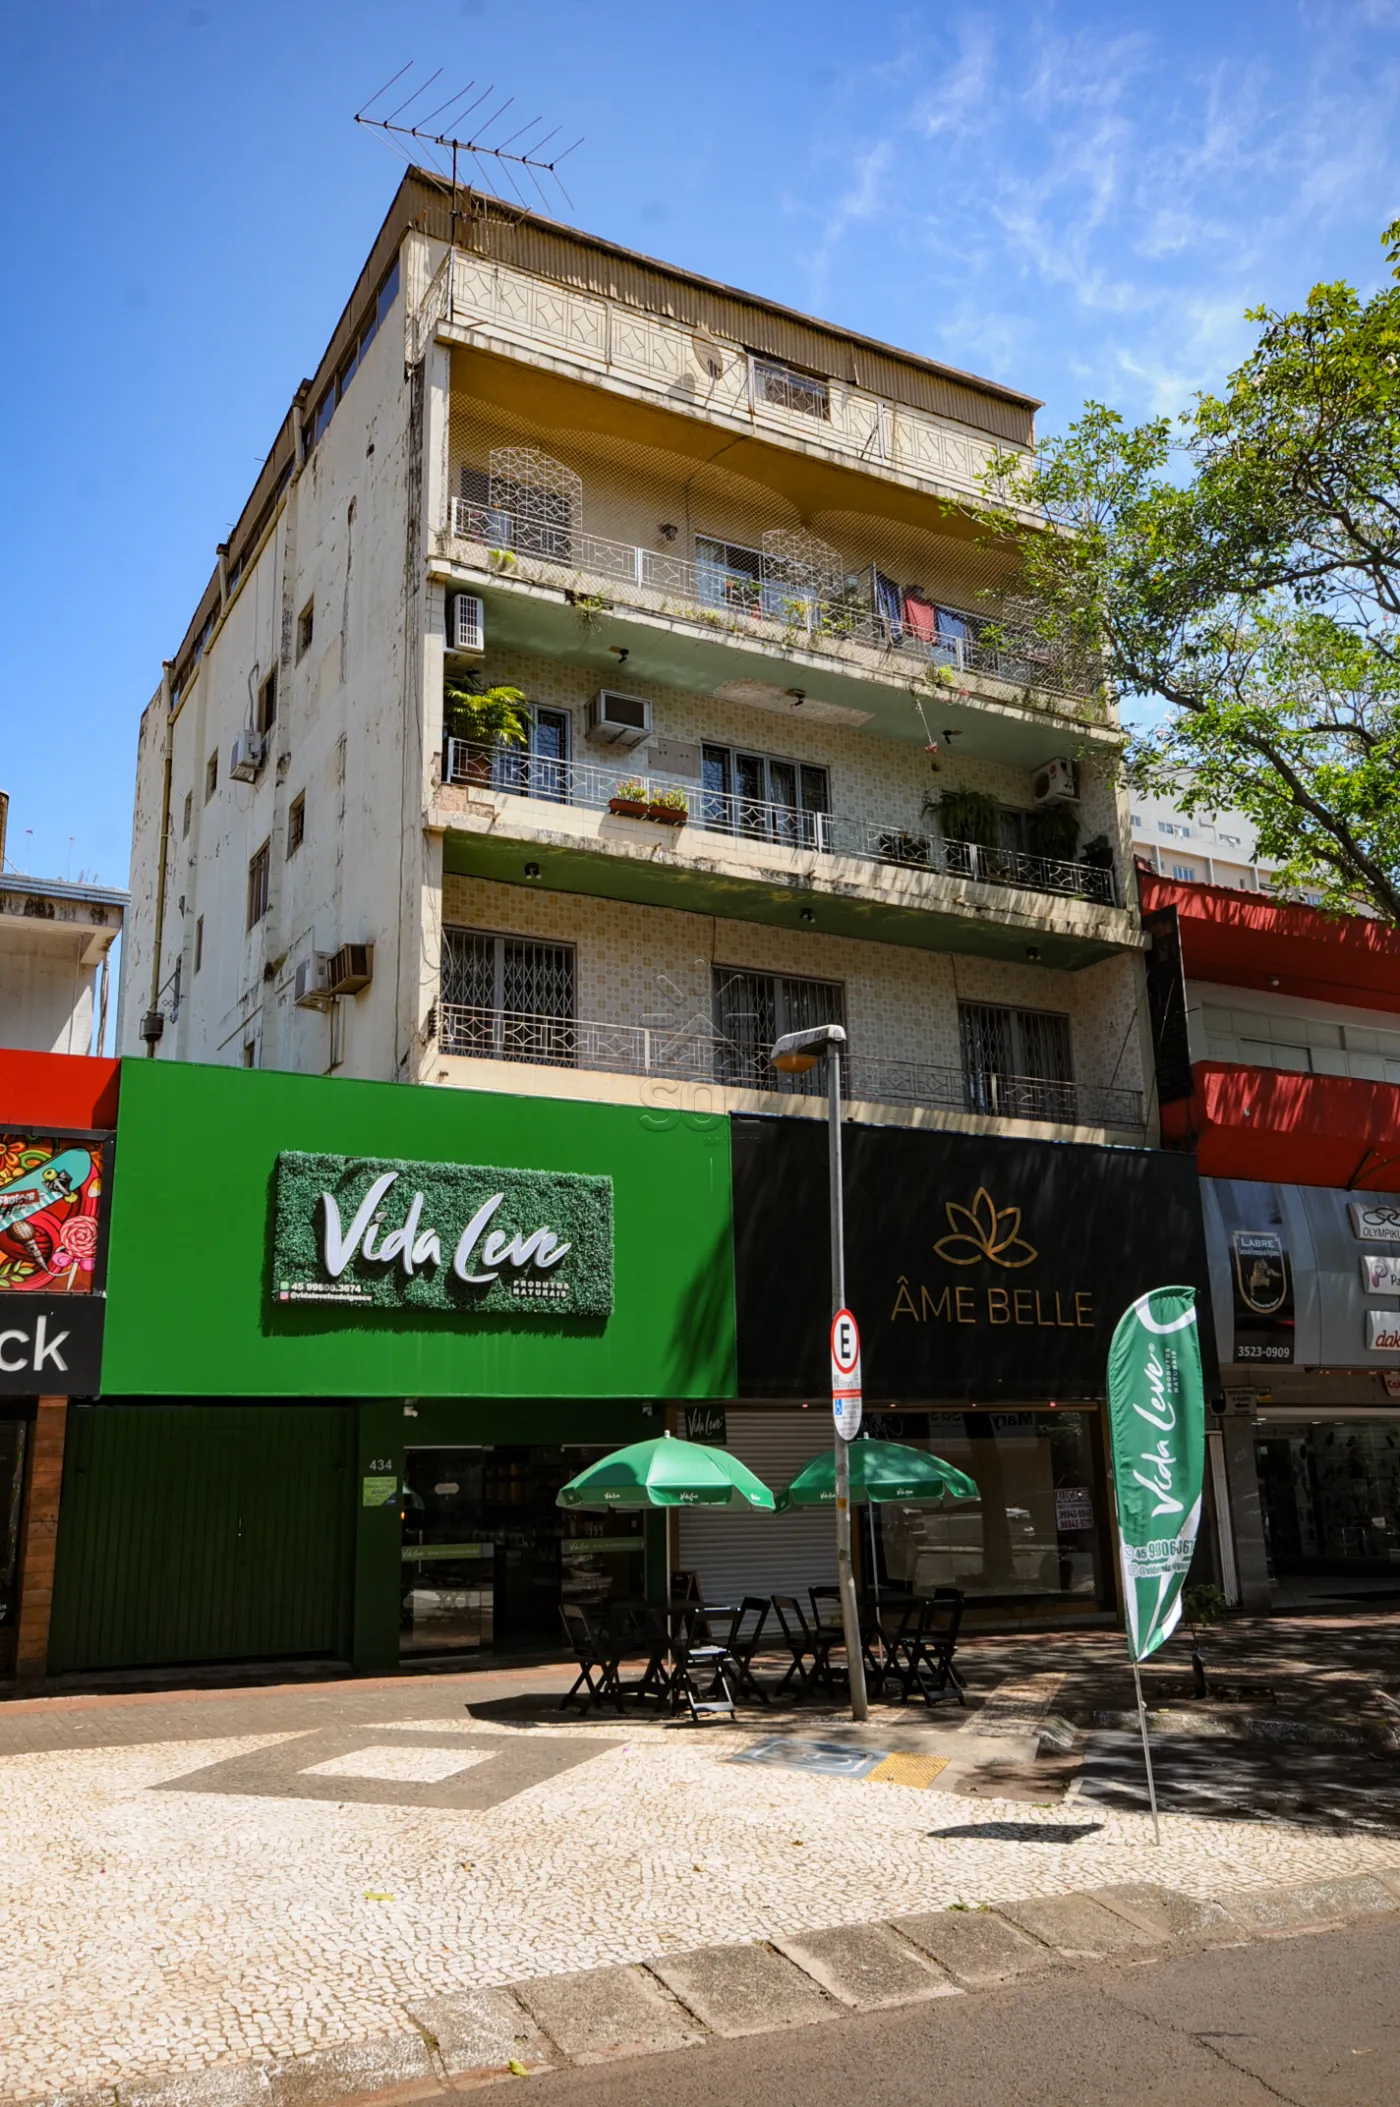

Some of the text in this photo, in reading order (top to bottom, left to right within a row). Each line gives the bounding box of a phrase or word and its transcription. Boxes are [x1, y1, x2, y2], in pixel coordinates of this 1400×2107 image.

[322, 1171, 572, 1283] Vida Leve
[1241, 1237, 1275, 1248] LABRE
[291, 1282, 304, 1291] 45
[513, 1280, 569, 1290] PRODUTOS
[513, 1288, 566, 1297] NATURAIS
[891, 1275, 1096, 1327] ÂME BELLE
[0, 1315, 71, 1372] ck
[840, 1323, 851, 1359] E
[1238, 1346, 1290, 1358] 3523-0909
[369, 1459, 392, 1471] 434
[1133, 1440, 1184, 1518] Vida
[1057, 1489, 1090, 1502] ALUGASE
[1136, 1548, 1147, 1559] 45
